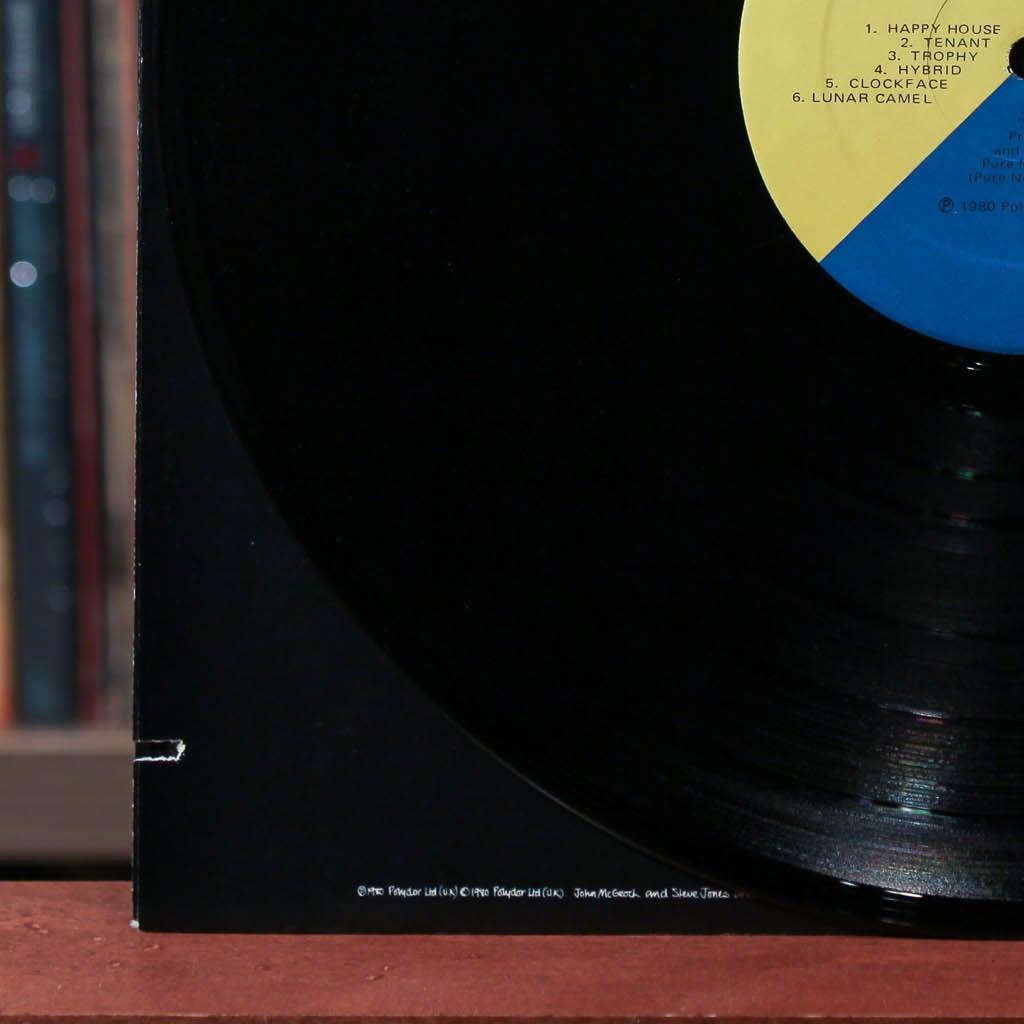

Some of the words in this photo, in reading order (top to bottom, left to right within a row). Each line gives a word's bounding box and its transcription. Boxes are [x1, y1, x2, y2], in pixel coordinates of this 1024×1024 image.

[865, 24, 877, 35] 1.
[888, 23, 940, 34] HAPPY
[947, 24, 1000, 35] HOUSE
[900, 38, 913, 48] 2.
[924, 37, 991, 48] TENANT
[888, 51, 900, 61] 3.
[911, 51, 978, 62] TROPHY
[874, 65, 887, 75] 4.
[899, 65, 962, 75] HYBRID
[825, 78, 838, 89] 5.
[849, 78, 948, 89] CLOCKFACE
[792, 92, 805, 103] 6.
[812, 92, 869, 103] LUNAR
[875, 93, 932, 104] CAMEL
[994, 145, 1020, 156] and
[982, 159, 1015, 169] Pure
[961, 200, 996, 213] 1980
[388, 885, 422, 899] Polydor
[424, 887, 438, 897] Ltd
[493, 885, 527, 899] Polydor
[528, 886, 541, 897] Ltd
[573, 887, 597, 899] John
[599, 887, 641, 899] McGeoch
[645, 888, 669, 899] and
[671, 887, 699, 899] Steve
[700, 887, 730, 899] Jones
